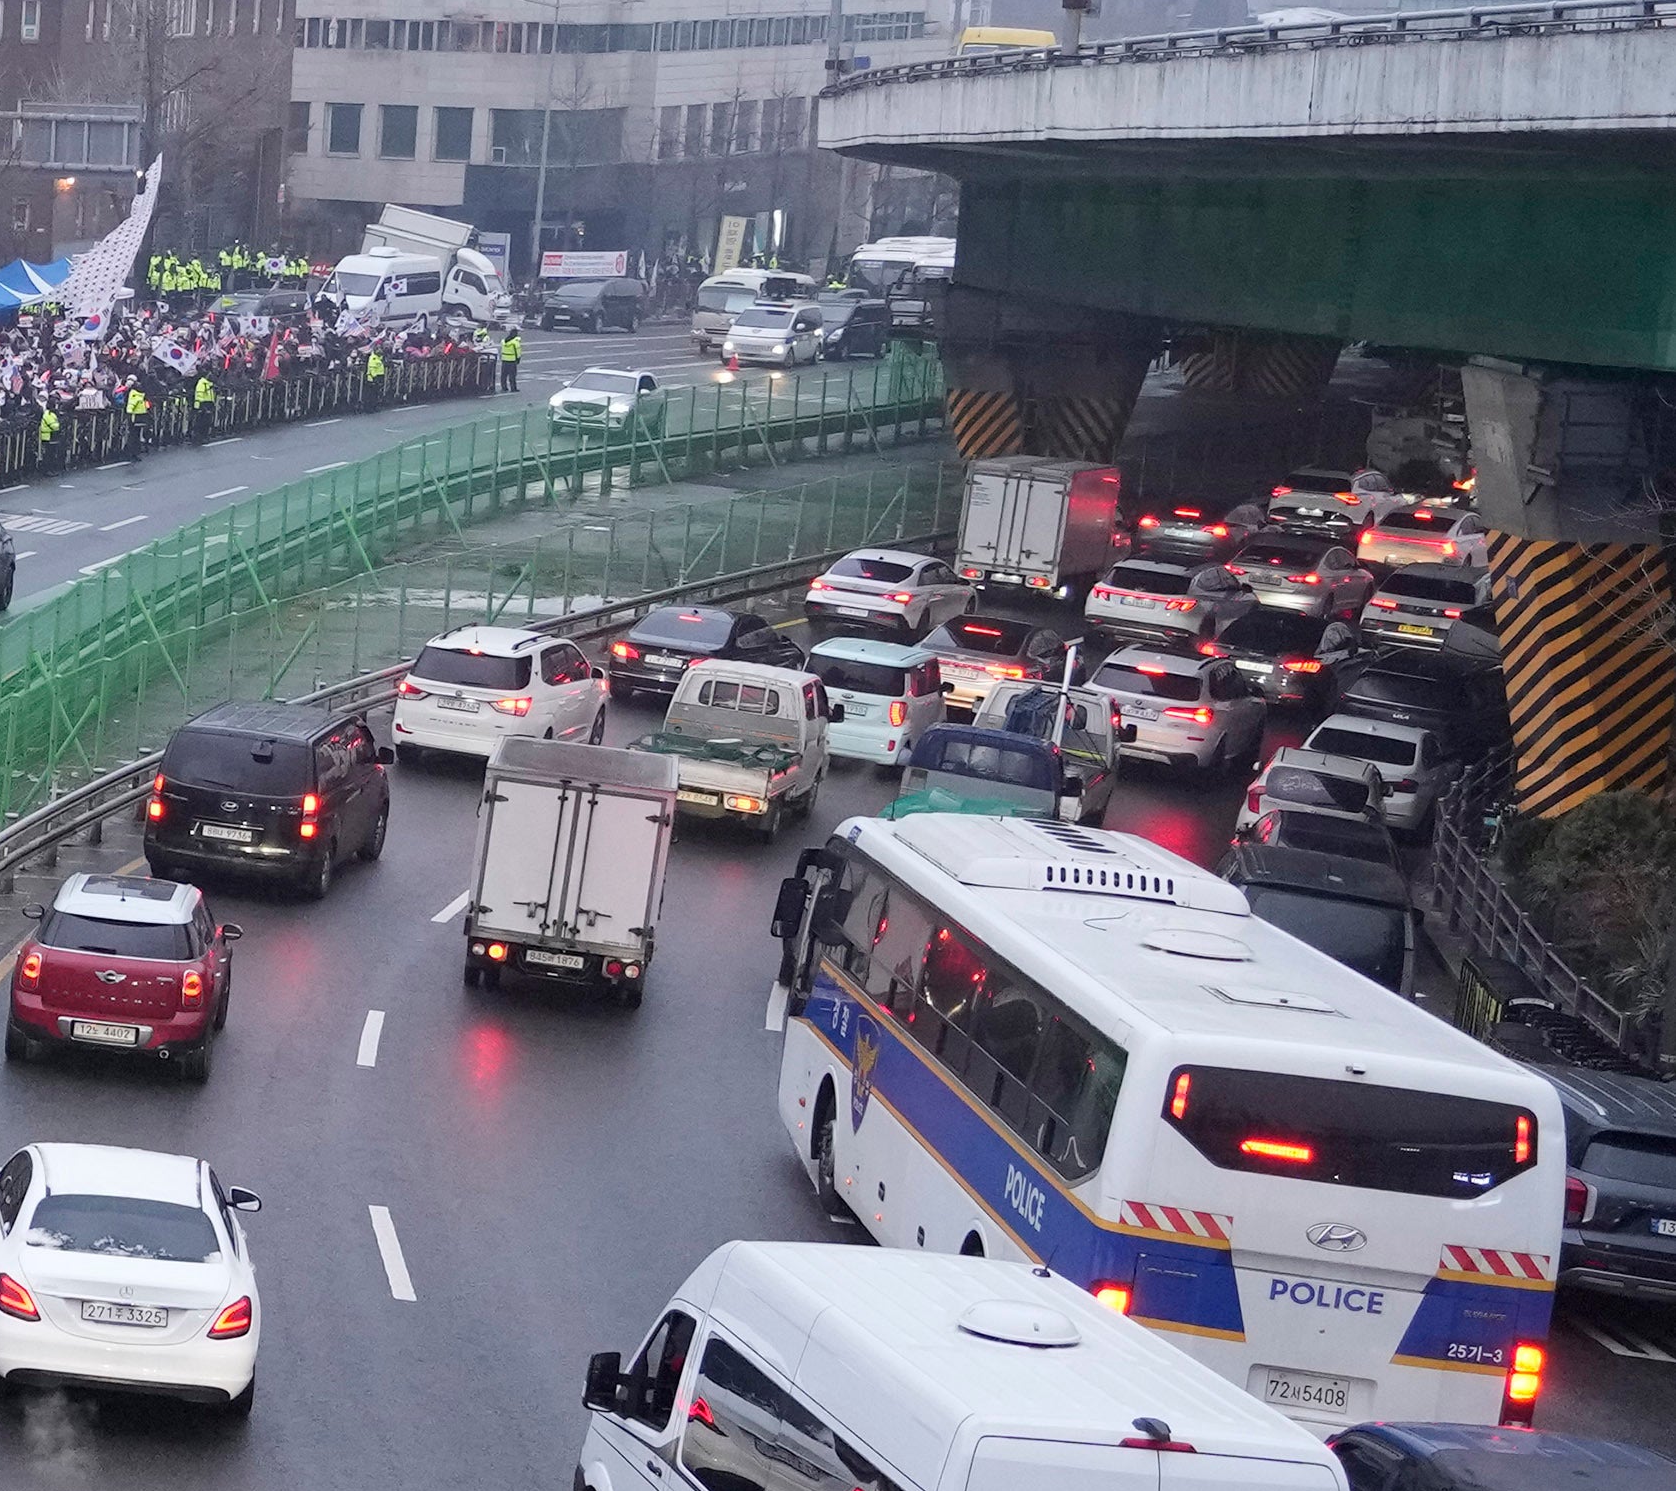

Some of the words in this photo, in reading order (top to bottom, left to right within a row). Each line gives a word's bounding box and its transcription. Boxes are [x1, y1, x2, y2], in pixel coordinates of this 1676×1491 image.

[556, 955, 581, 967] 1876
[102, 1027, 131, 1039] 4402
[1004, 1163, 1045, 1233] POLICE
[1269, 1278, 1384, 1315] POLICE
[125, 1306, 162, 1324] 3325
[1447, 1343, 1503, 1363] 25기-3
